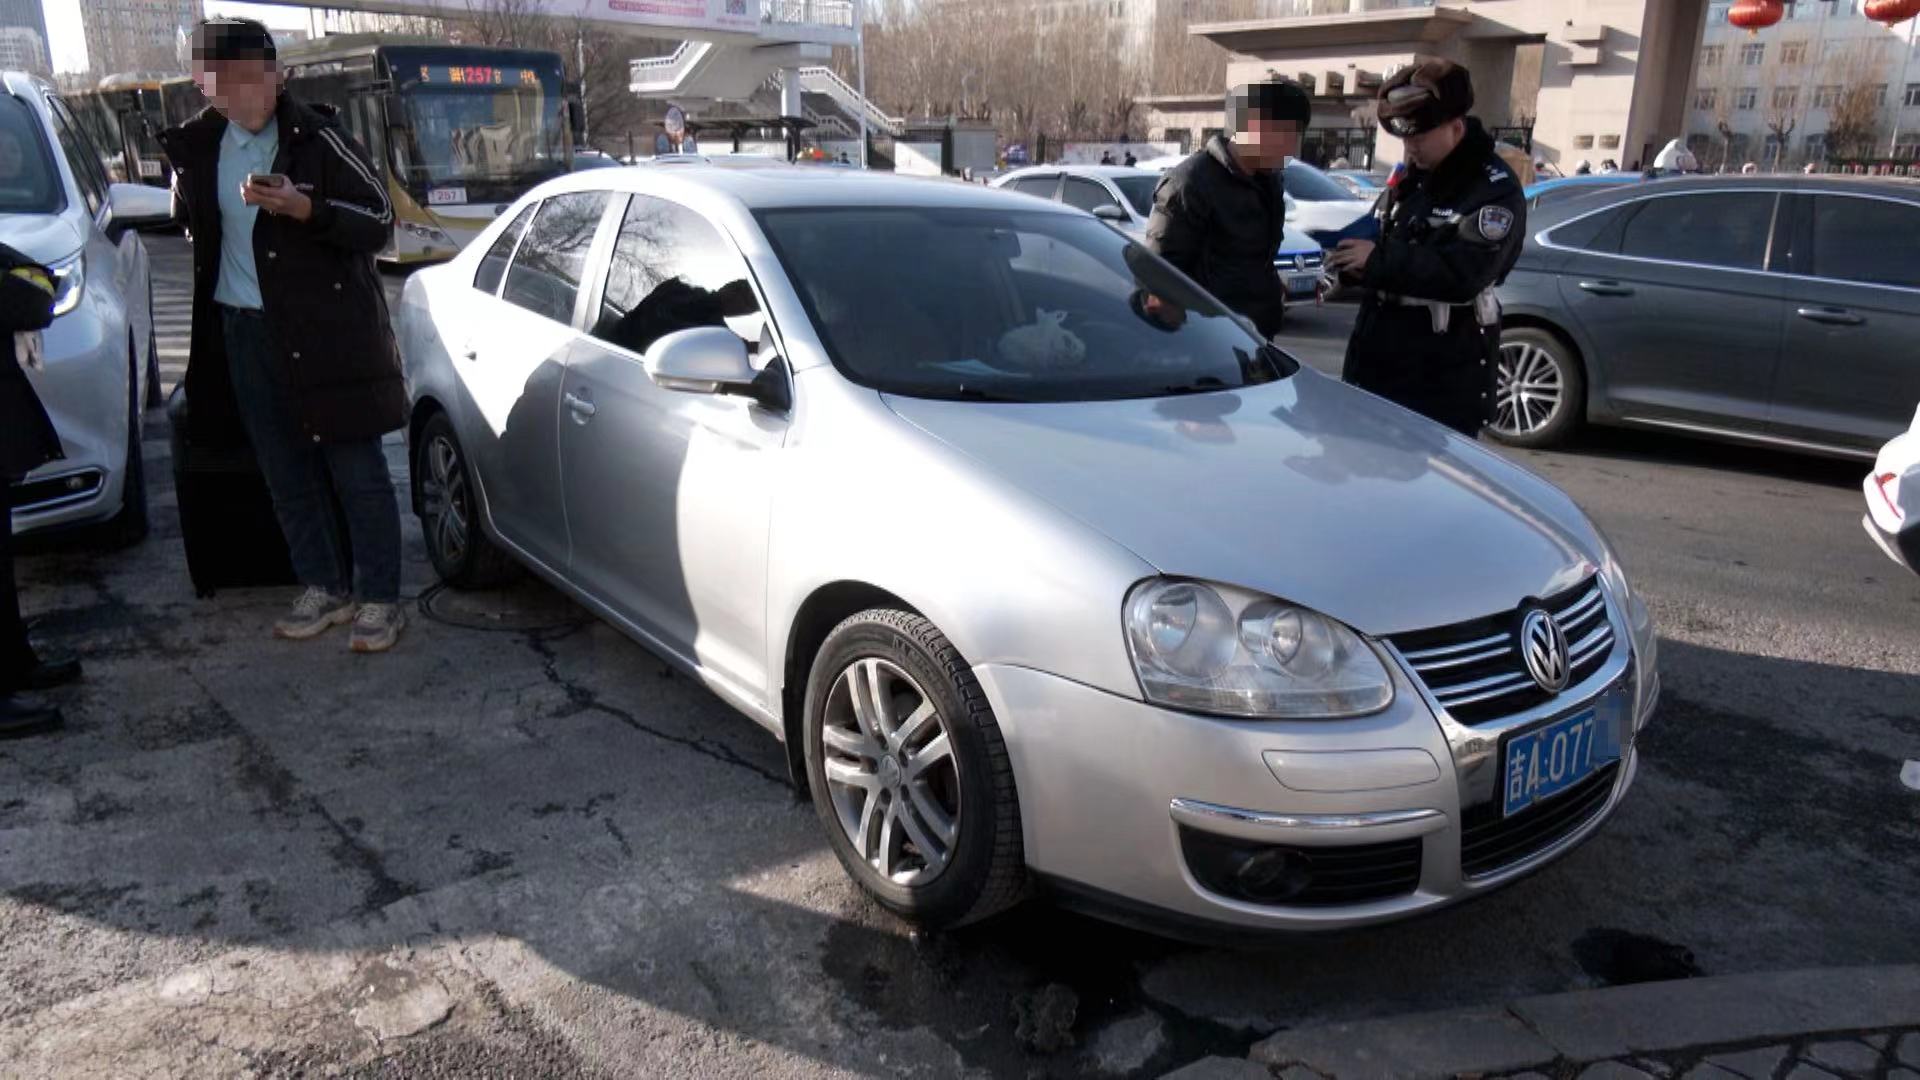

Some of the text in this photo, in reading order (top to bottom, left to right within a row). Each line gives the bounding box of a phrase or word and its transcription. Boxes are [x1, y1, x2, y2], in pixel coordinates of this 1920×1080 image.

[466, 66, 492, 85] 257
[435, 191, 456, 201] 257
[1510, 718, 1594, 801] 吉A·077
